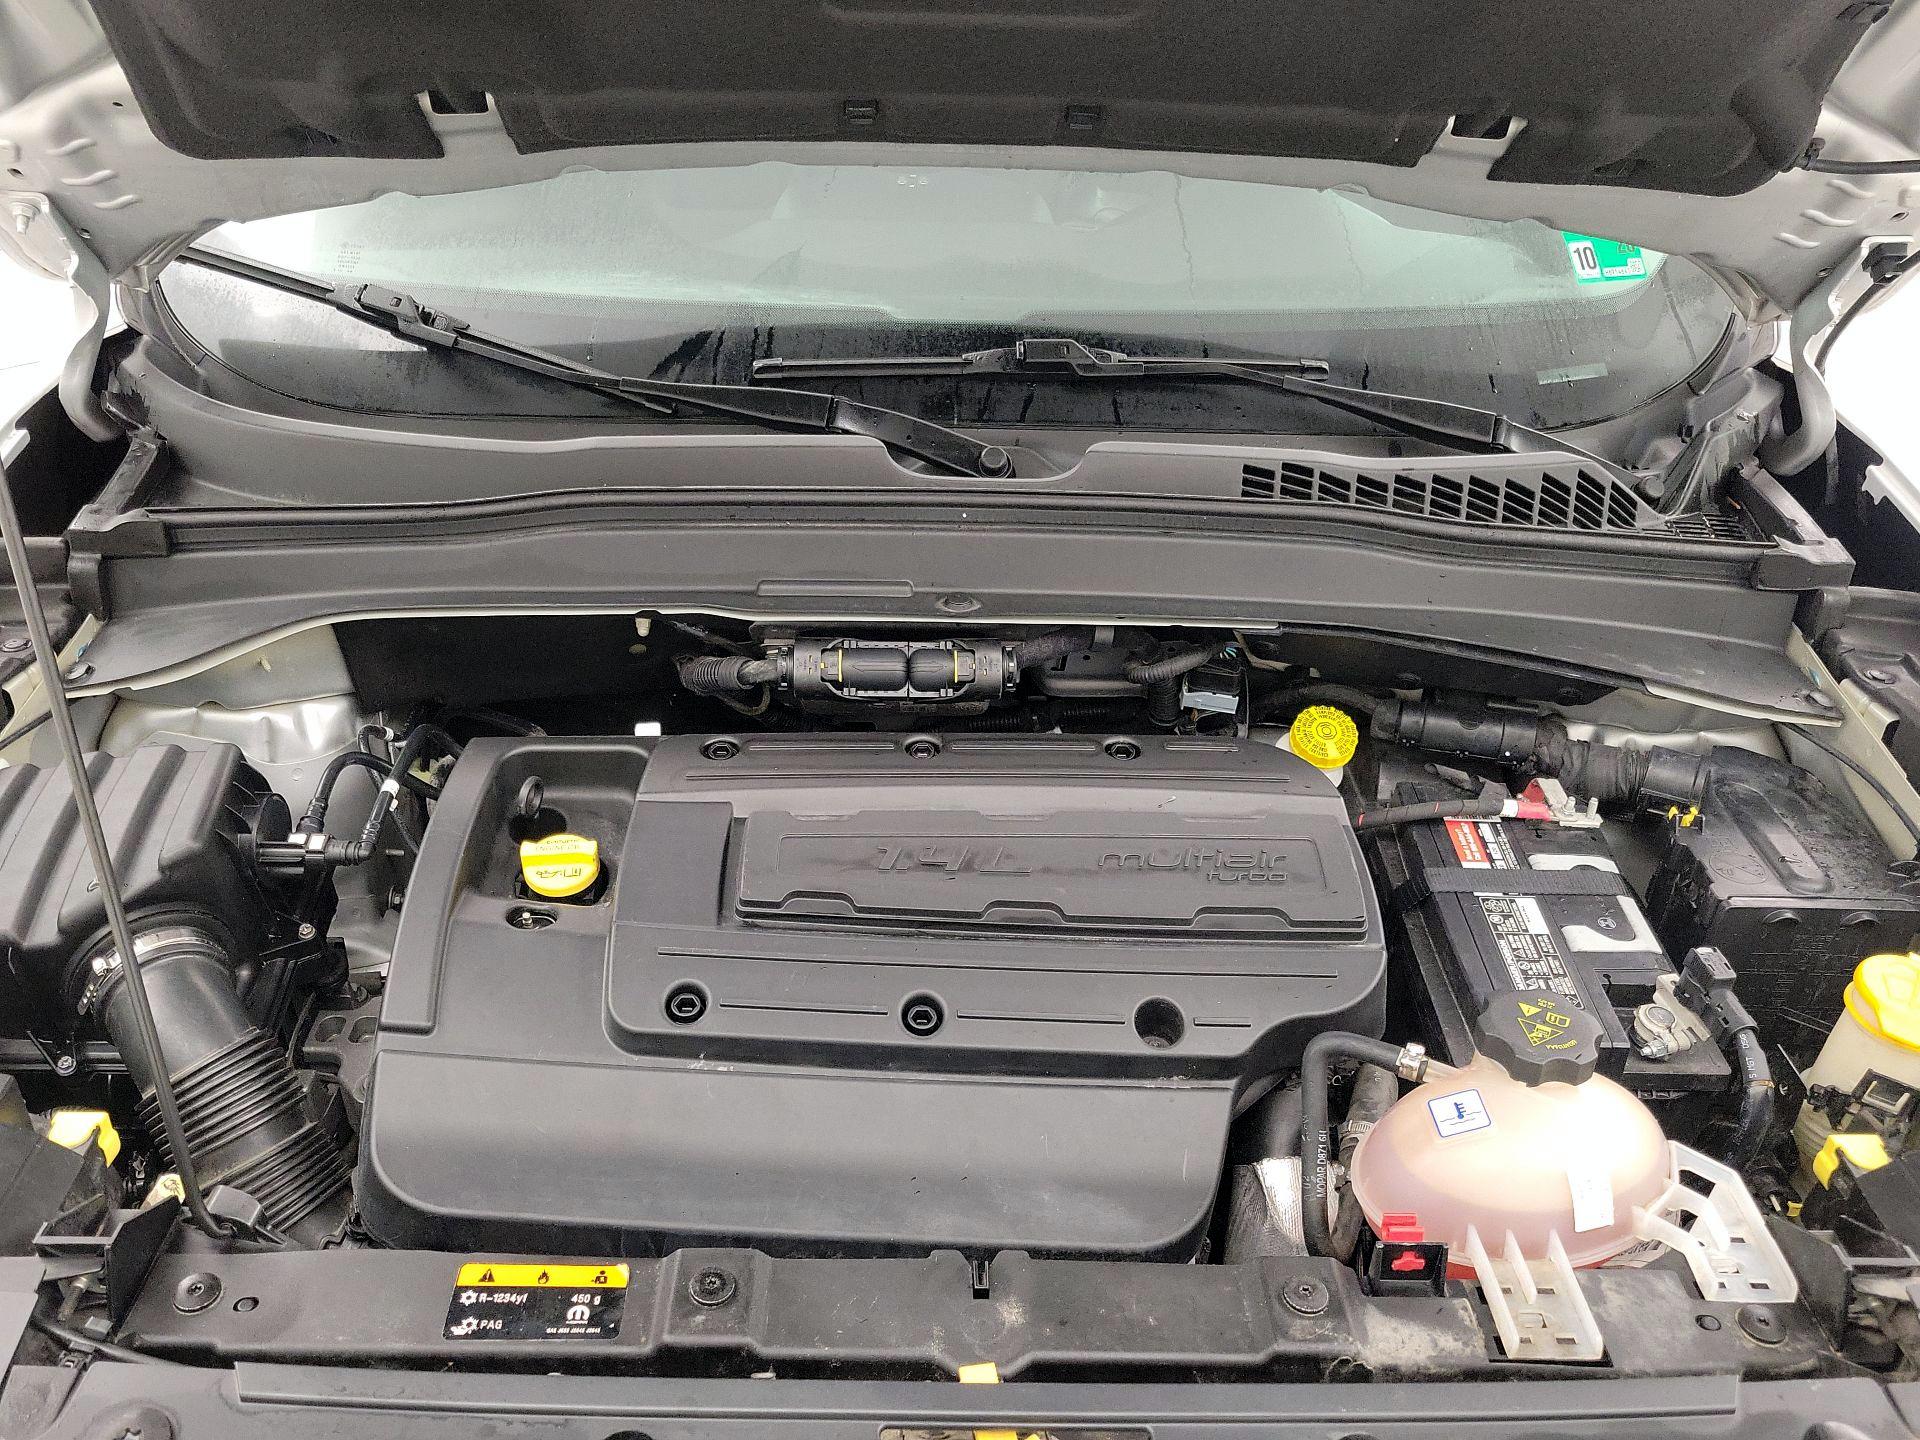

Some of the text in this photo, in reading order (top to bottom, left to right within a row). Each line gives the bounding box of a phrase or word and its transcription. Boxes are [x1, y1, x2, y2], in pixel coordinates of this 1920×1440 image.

[1573, 246, 1597, 270] 10
[1098, 848, 1288, 869] multiair
[1207, 869, 1289, 882] turbo
[1316, 1166, 1327, 1199] MOPAR
[570, 1293, 591, 1303] 450
[593, 1294, 601, 1305] g
[479, 1319, 503, 1330] PAG
